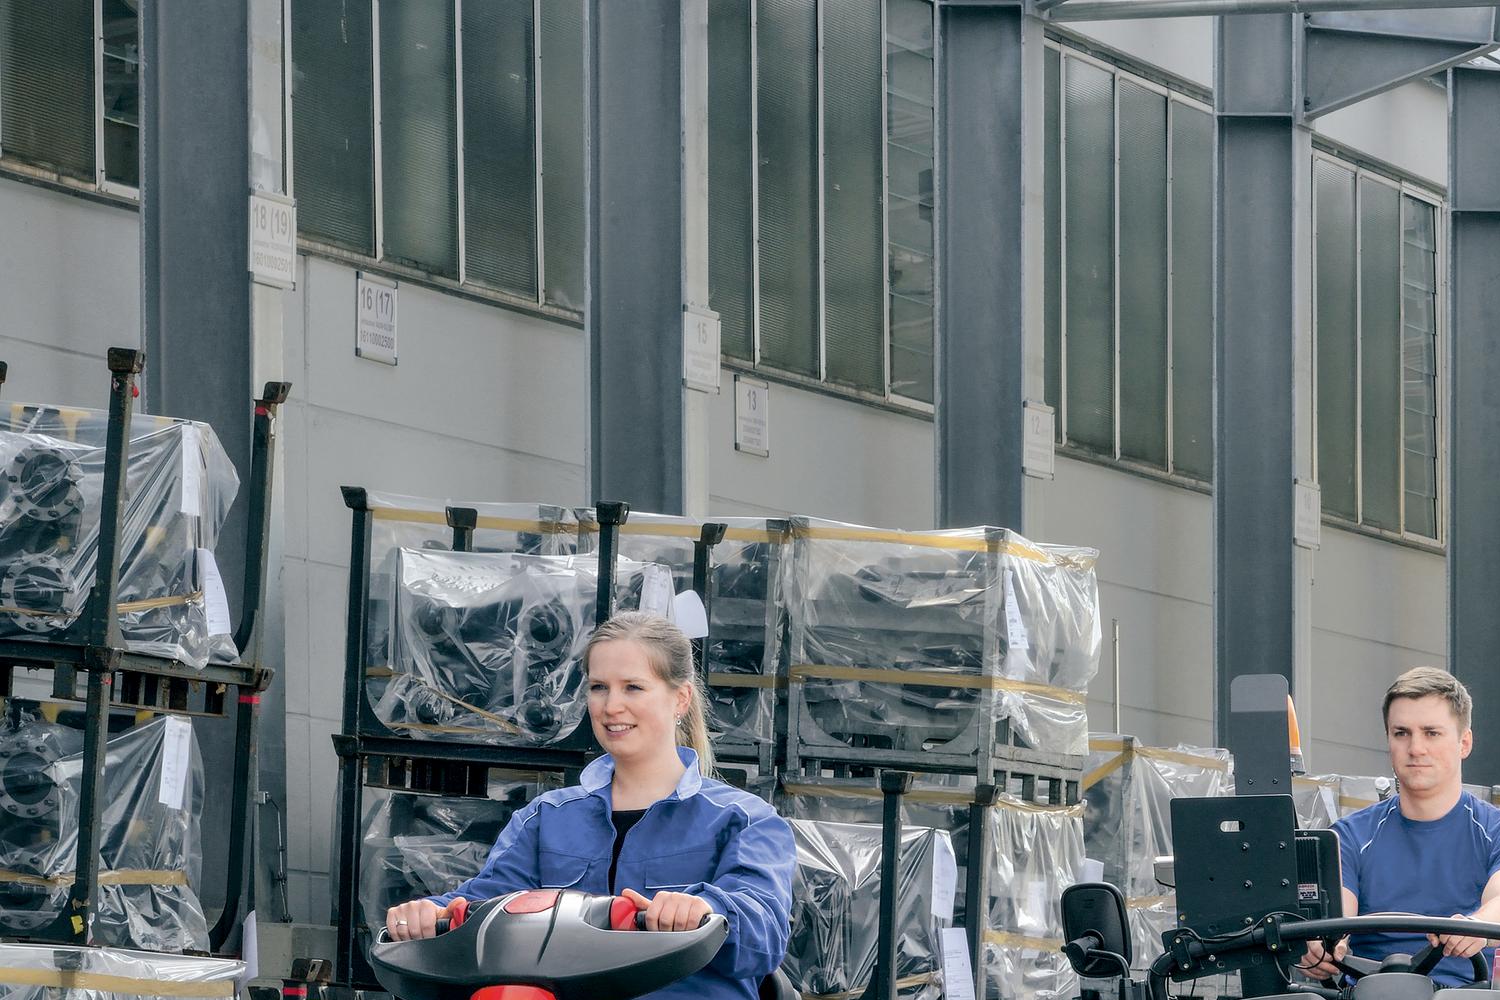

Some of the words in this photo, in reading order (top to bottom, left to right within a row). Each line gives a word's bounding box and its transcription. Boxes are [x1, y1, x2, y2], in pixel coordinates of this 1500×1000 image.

[254, 204, 267, 231] 18
[271, 206, 292, 243] (19)
[361, 287, 373, 311] 16
[376, 289, 394, 323] (17)
[697, 321, 708, 345] 15
[747, 389, 757, 411] 13
